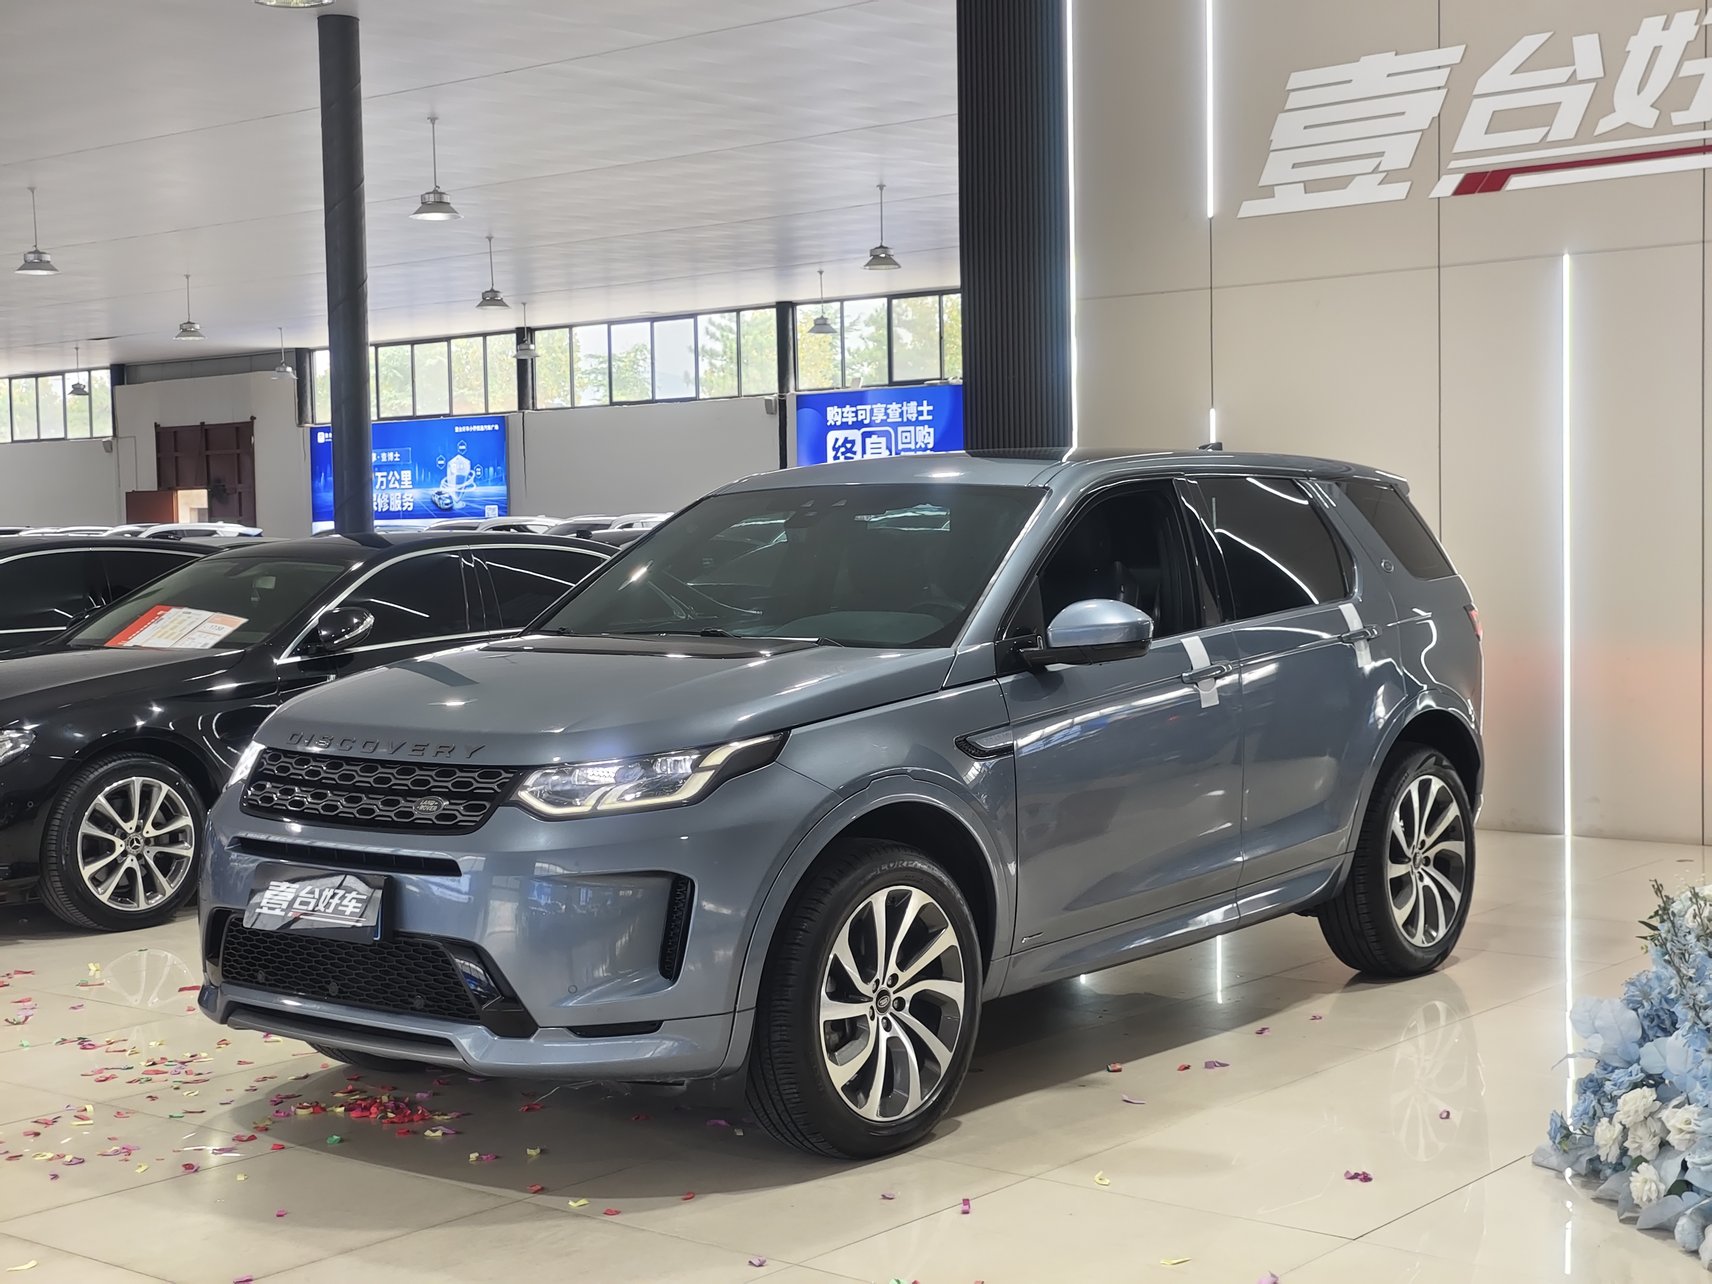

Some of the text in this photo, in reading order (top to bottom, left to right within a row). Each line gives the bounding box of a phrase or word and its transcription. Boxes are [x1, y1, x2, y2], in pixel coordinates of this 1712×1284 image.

[826, 400, 934, 426] 购车可享查博士
[897, 425, 934, 450] 回购
[286, 731, 486, 759] DISCOVERY
[255, 881, 368, 916] 壹台好车
